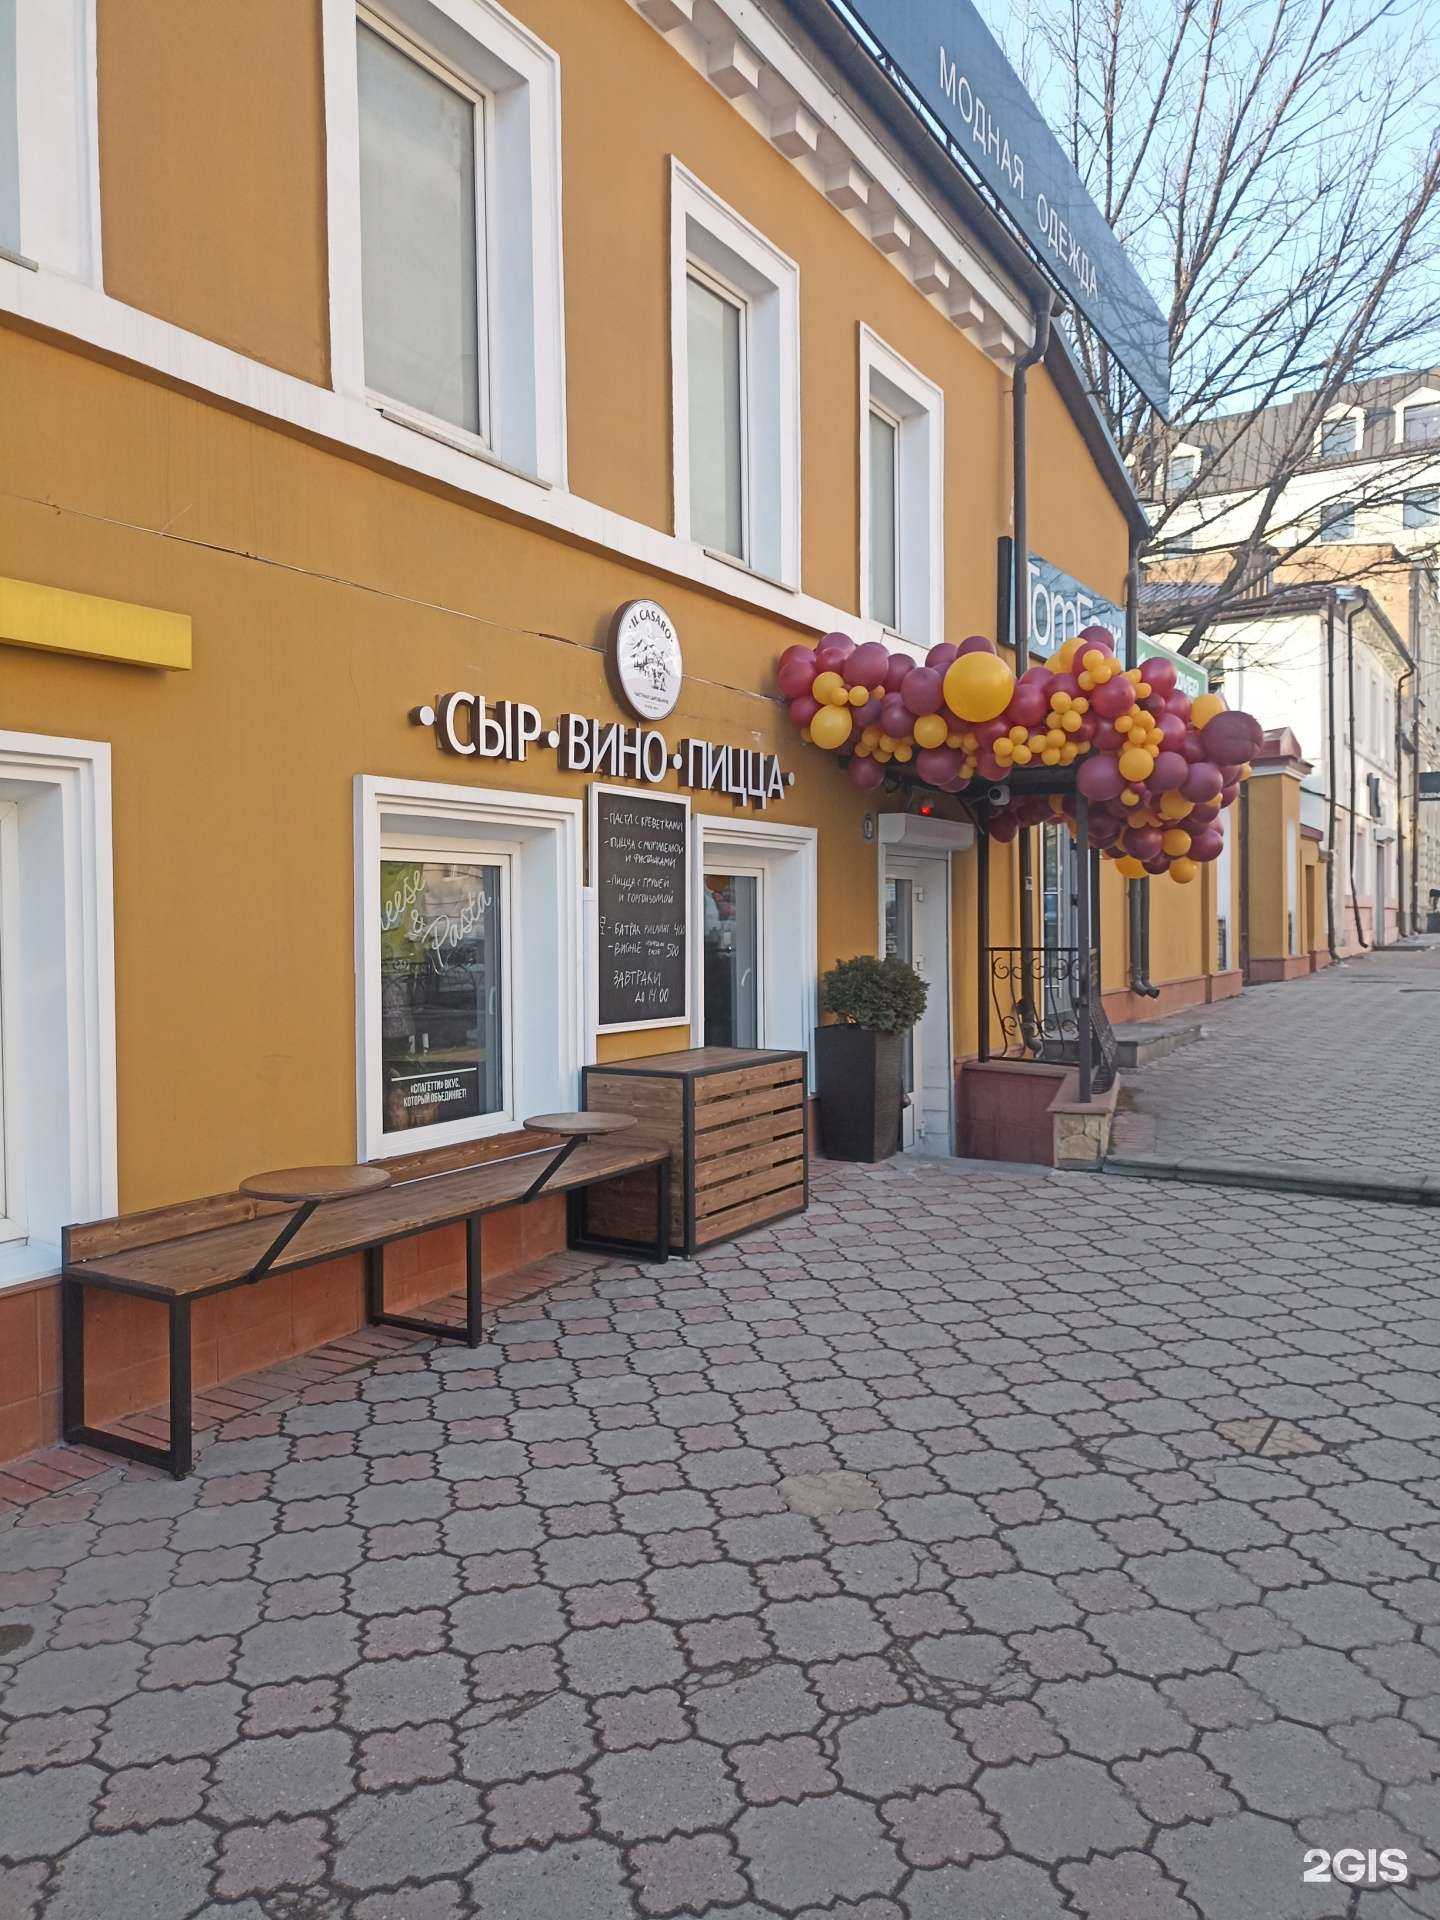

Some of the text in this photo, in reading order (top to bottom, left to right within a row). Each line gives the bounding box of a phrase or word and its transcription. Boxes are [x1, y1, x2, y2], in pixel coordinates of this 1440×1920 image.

[939, 46, 1099, 300] МОДНАЯ ОДЕЖДА
[639, 609, 672, 640] CASARO
[445, 691, 785, 810] СЫР ВИНО ПИЦЦА
[411, 909, 426, 933] &
[421, 891, 492, 968] Pasta
[614, 970, 662, 989] ЗАВТРАКИ
[403, 1092, 430, 1107] КОТОРЫЙ
